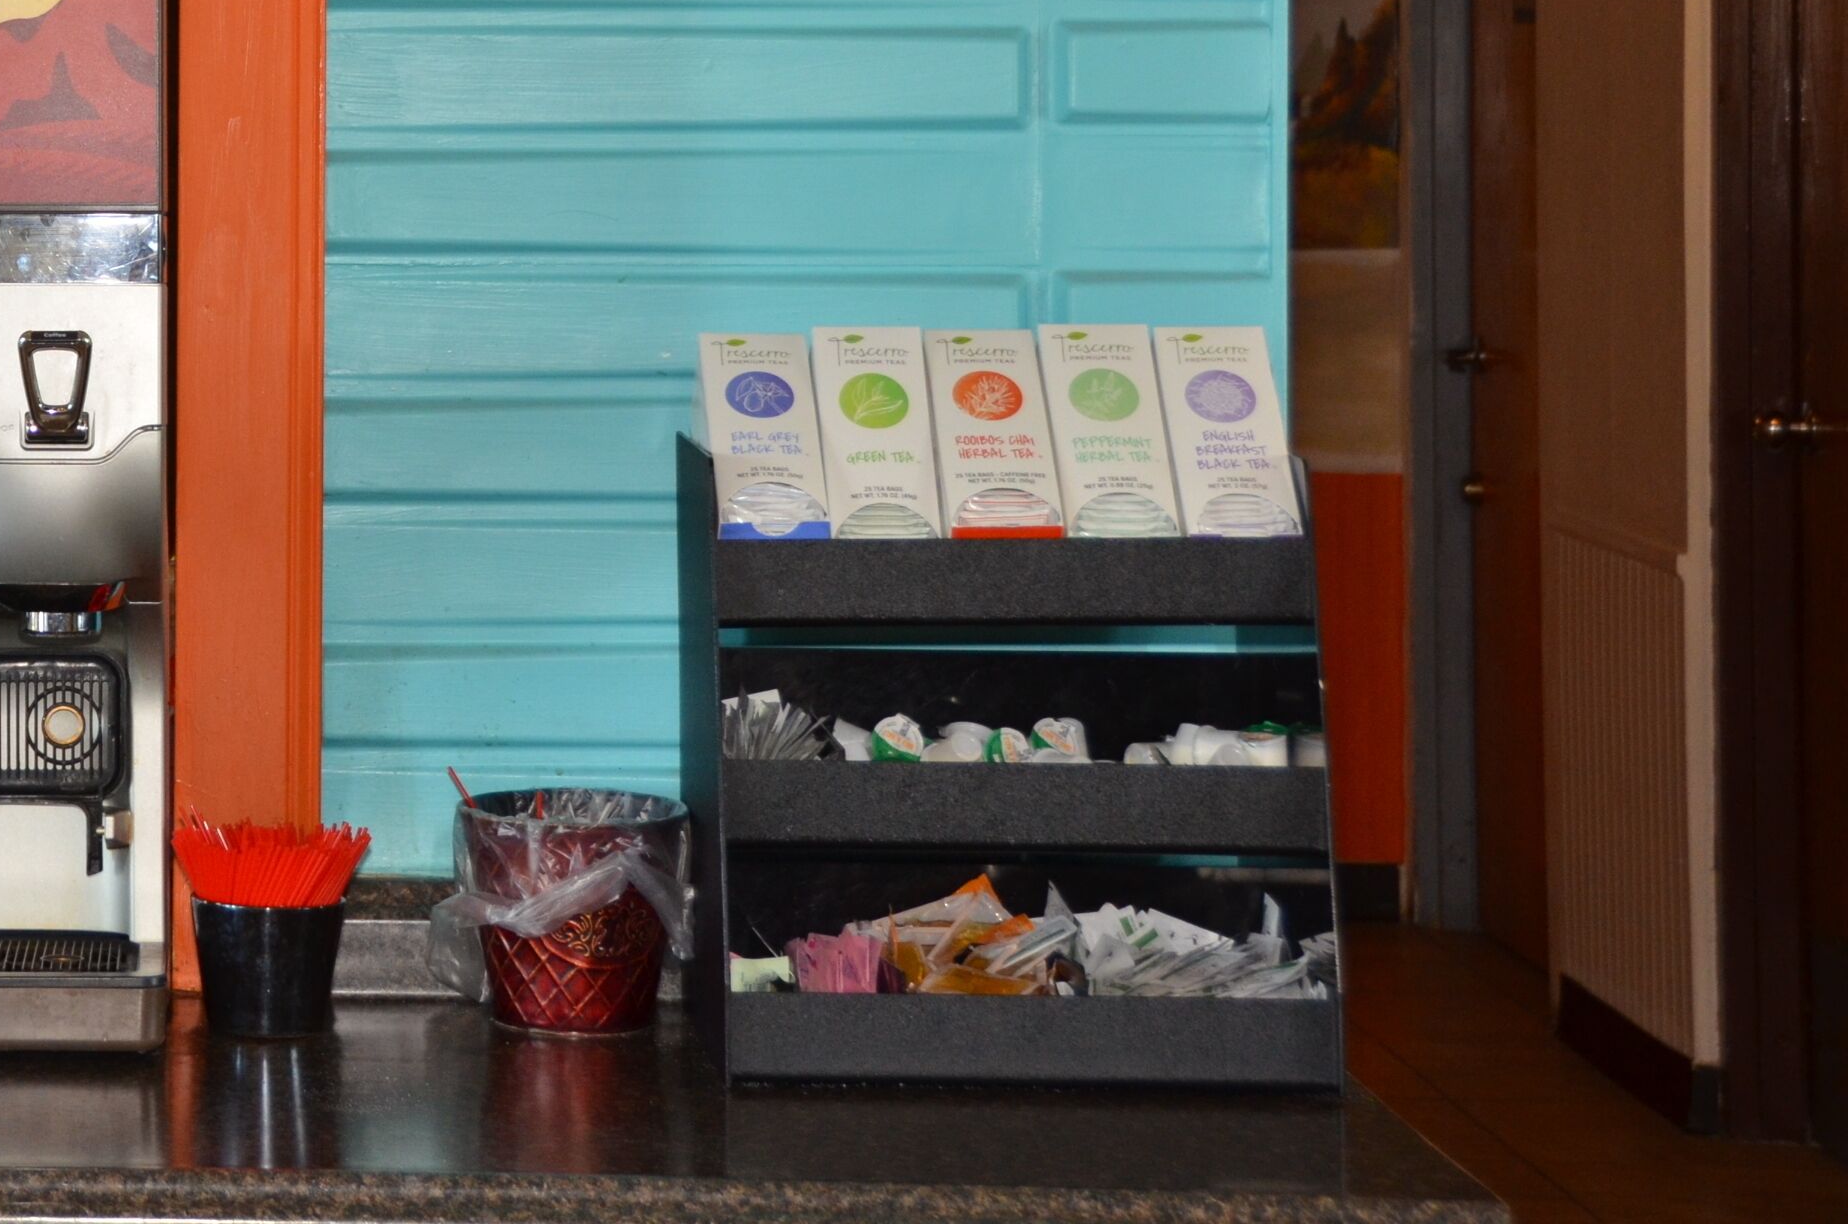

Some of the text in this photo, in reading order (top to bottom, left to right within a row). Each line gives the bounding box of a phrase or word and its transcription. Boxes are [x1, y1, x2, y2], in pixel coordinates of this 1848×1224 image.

[731, 431, 800, 443] EARL GREY
[955, 434, 1035, 446] ROOIBOS CHAI
[1072, 435, 1152, 448] PEPPERMINT
[1202, 431, 1255, 442] ENGLISH
[731, 444, 803, 455] BLACK TEA
[959, 448, 1034, 459] HERBAL TEA
[1195, 445, 1267, 456] BREAKFAST
[846, 451, 915, 464] GREEN TEA
[1074, 451, 1151, 463] HERBAL TEA
[1196, 459, 1271, 470] BLACK TEA
